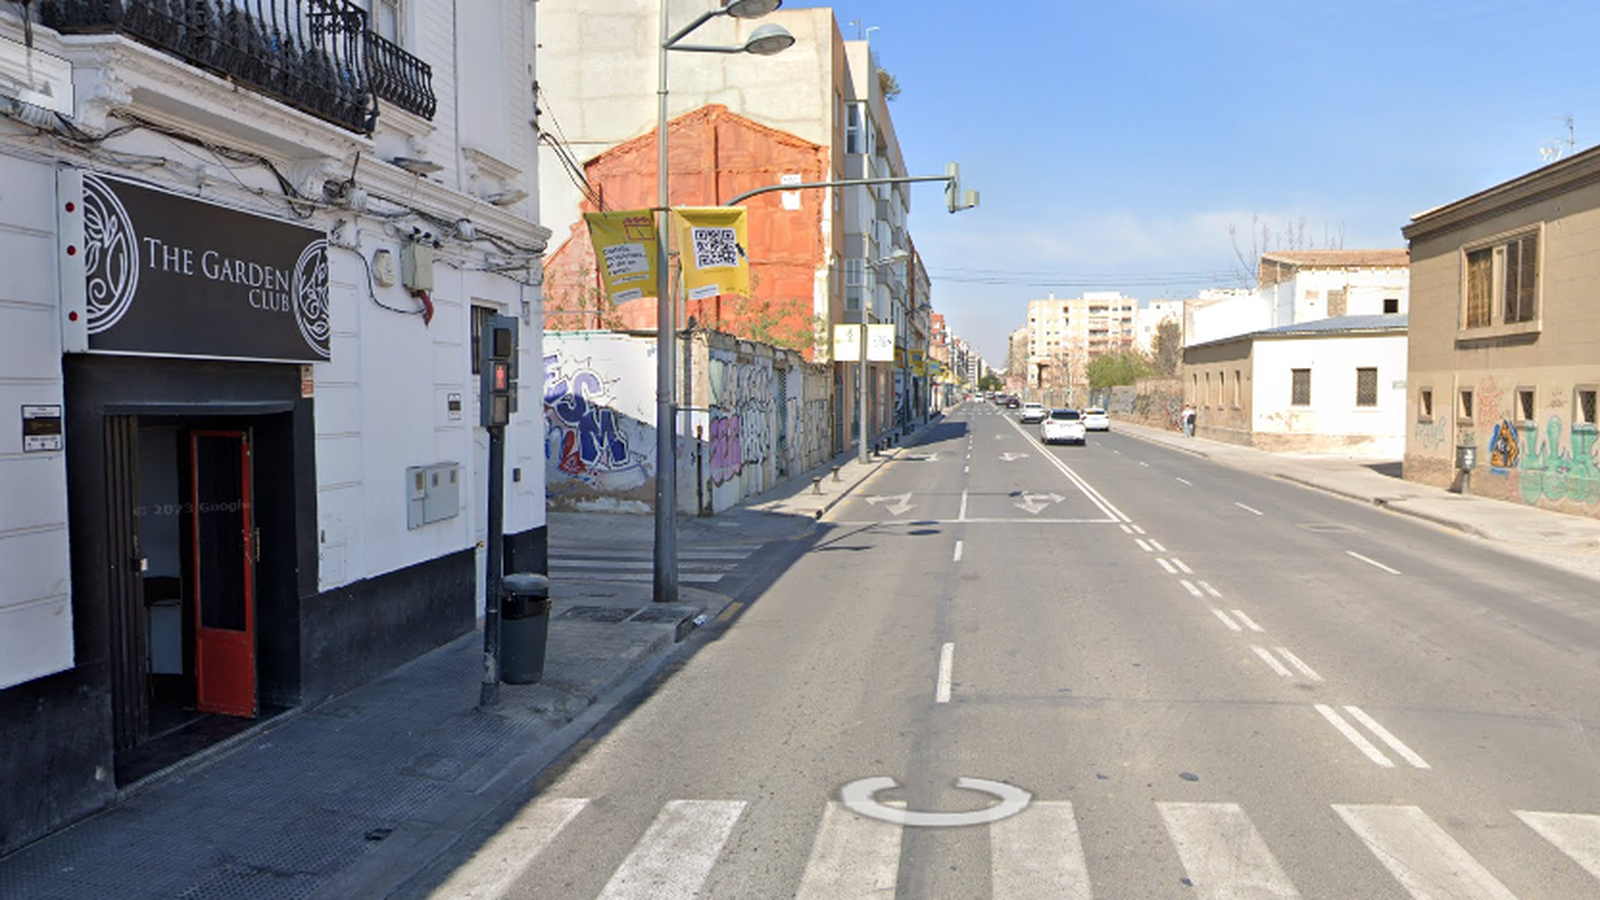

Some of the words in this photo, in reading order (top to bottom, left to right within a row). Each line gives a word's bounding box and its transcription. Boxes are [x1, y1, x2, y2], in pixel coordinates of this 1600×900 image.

[144, 237, 194, 275] THE
[202, 250, 290, 291] GARDEN
[249, 289, 290, 312] CLUB
